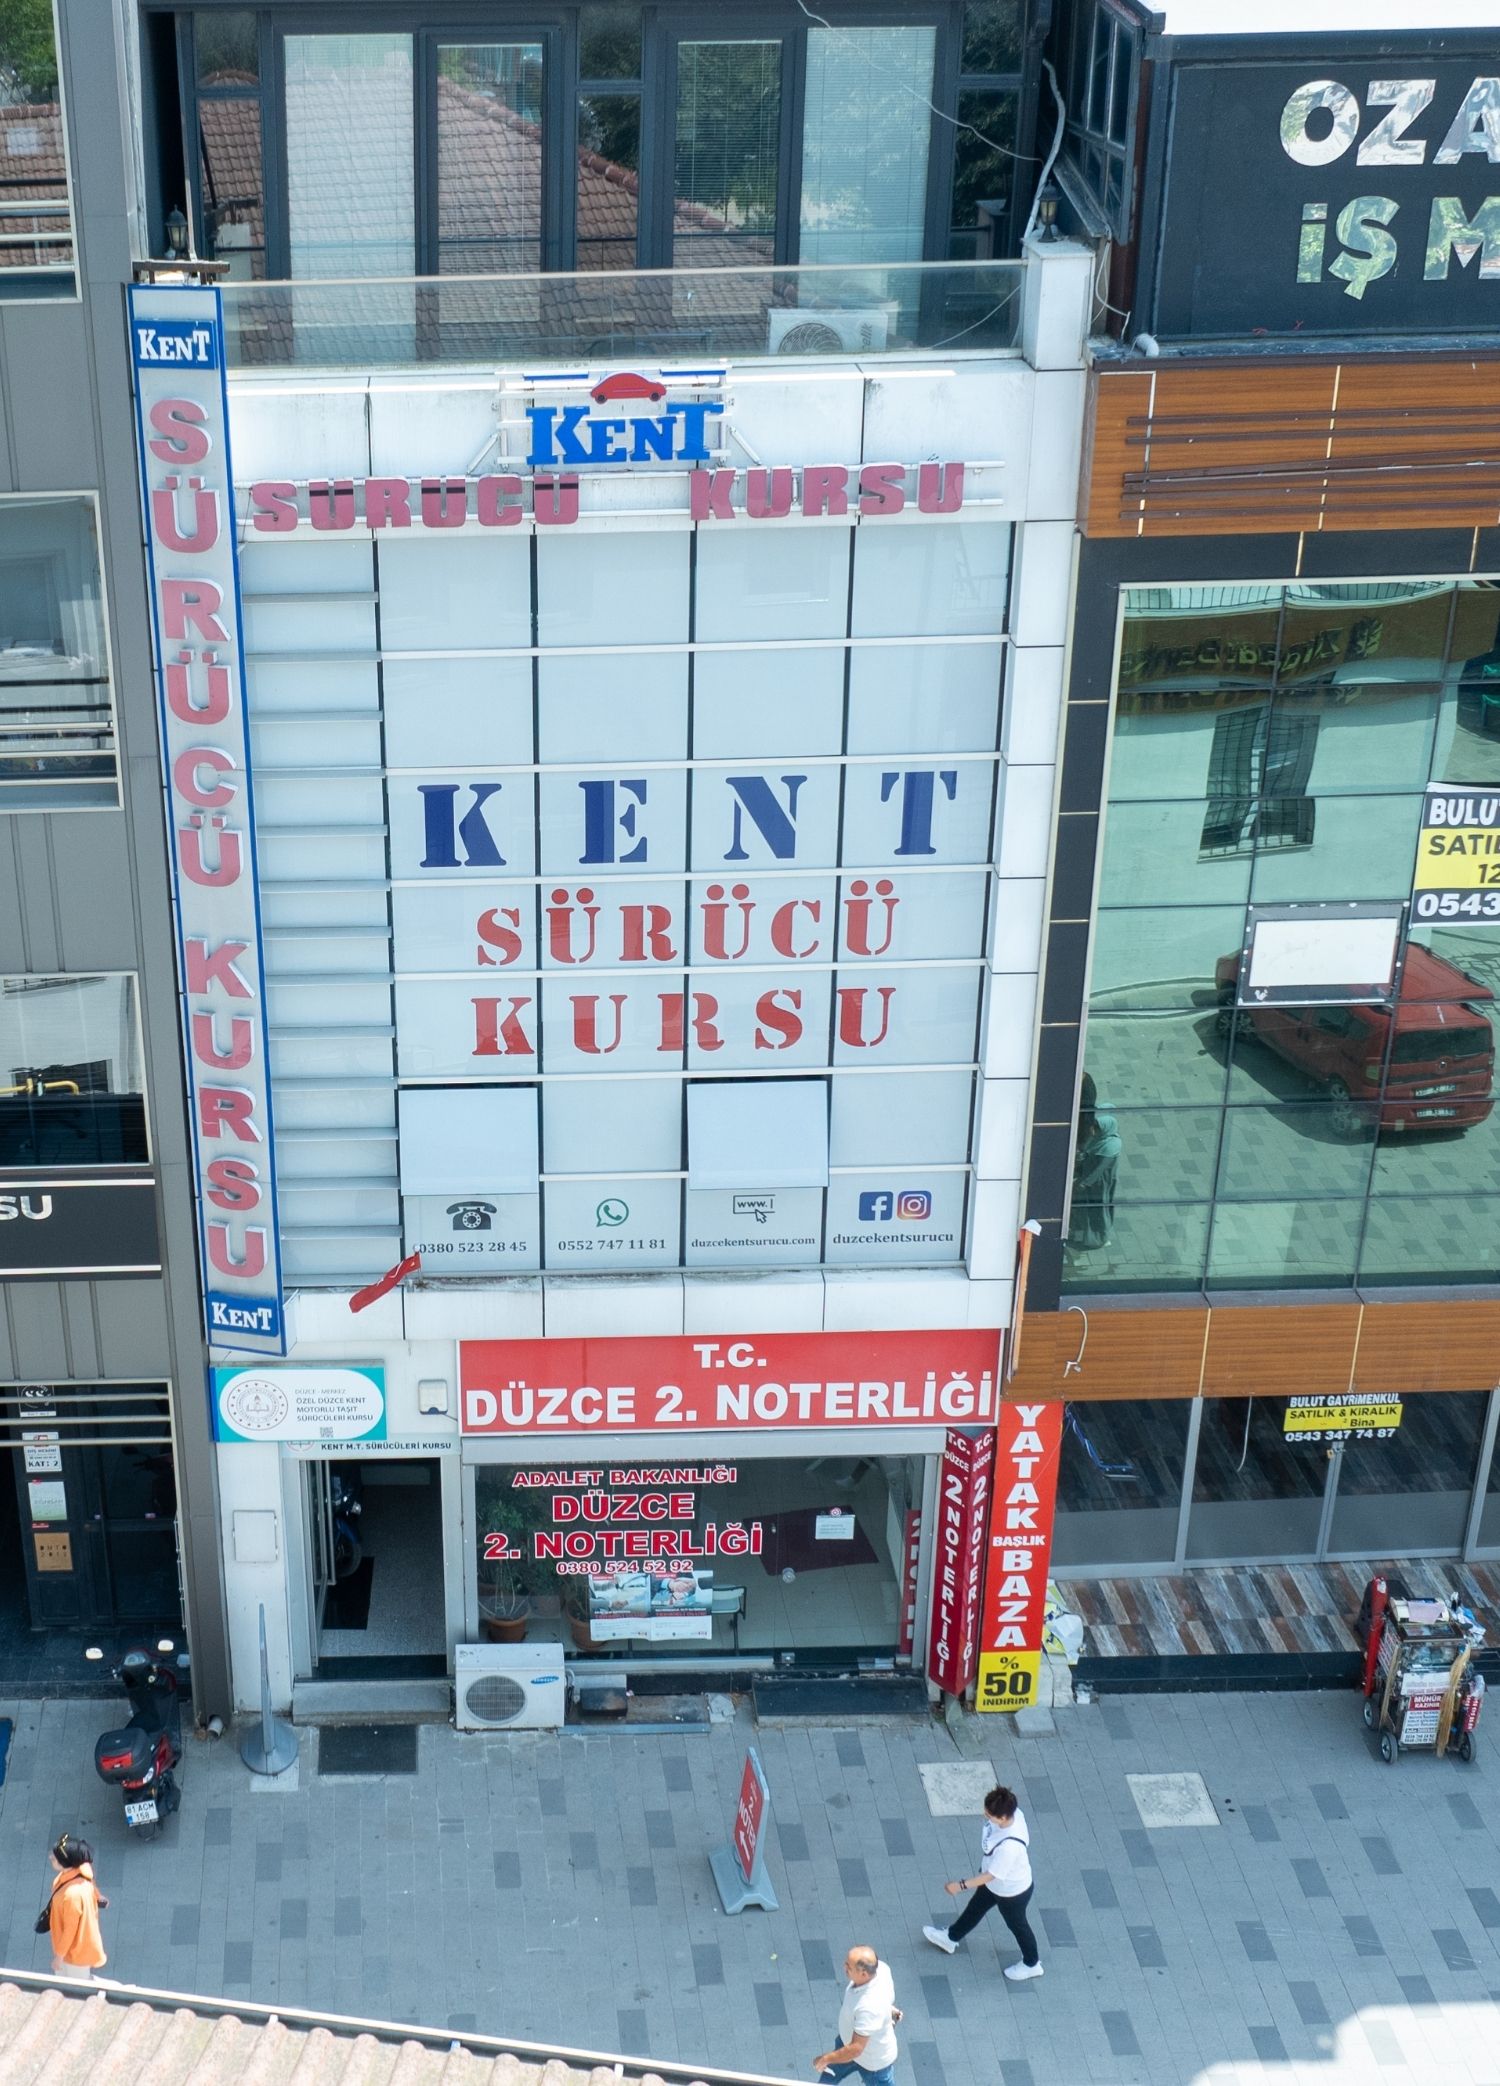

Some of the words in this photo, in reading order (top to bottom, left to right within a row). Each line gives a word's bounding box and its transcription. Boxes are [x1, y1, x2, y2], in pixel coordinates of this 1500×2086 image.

[137, 328, 211, 362] KENT
[525, 401, 724, 465] KENT
[690, 462, 965, 521] KURSU
[148, 398, 247, 889] SÜRÜCÜ
[416, 770, 958, 868] KENT
[1429, 798, 1500, 826] BULU
[476, 878, 900, 967] SÜRÜCÜ
[470, 987, 897, 1056] KURSU
[184, 935, 269, 1280] KURSU
[419, 1242, 454, 1254] 0380
[458, 1242, 484, 1253] 523
[488, 1241, 506, 1252] 28
[509, 1241, 527, 1252] 45
[558, 1240, 593, 1251] 0552
[597, 1239, 623, 1250] 747
[629, 1240, 644, 1249] 11
[648, 1239, 666, 1249] 81
[691, 1237, 816, 1248] duzcekentsurucu.com
[832, 1232, 954, 1245] duzcekentsurucu
[211, 1302, 273, 1332] KENT
[693, 1343, 767, 1368] T.C.
[346, 1396, 366, 1404] KENT
[466, 1381, 635, 1426] DÜZCE
[654, 1386, 697, 1422] 2.
[716, 1370, 992, 1421] NOTERLİĞİ
[1290, 1396, 1325, 1408] BULUT
[347, 1413, 374, 1422] KURSU
[1290, 1408, 1336, 1419] SATILIK
[1338, 1408, 1347, 1417] &
[1350, 1418, 1375, 1427] Bina
[366, 1441, 420, 1450] SÜRÜCÜLERİ
[422, 1442, 452, 1450] KURSU
[947, 1430, 971, 1455] T.C.
[975, 1433, 993, 1454] T.C.
[1285, 1431, 1321, 1442] 0543
[1325, 1430, 1352, 1440] 347
[1355, 1429, 1374, 1439] 74
[1376, 1428, 1396, 1438] 87
[512, 1470, 603, 1487] ADALET
[609, 1464, 738, 1485] BAKANLIĞI
[1004, 1405, 1046, 1530] YATAK
[552, 1489, 695, 1523] DÜZCE
[484, 1532, 521, 1560] 2.
[534, 1522, 762, 1559] NOTERLİĞİ
[992, 1534, 1046, 1548] BAŞLIK
[556, 1561, 600, 1575] 0380
[605, 1560, 638, 1574] 524
[643, 1560, 666, 1574] 52
[669, 1559, 693, 1573] 92
[993, 1549, 1034, 1648] BAZA
[1000, 1656, 1019, 1670] %
[984, 1671, 1032, 1697] 50
